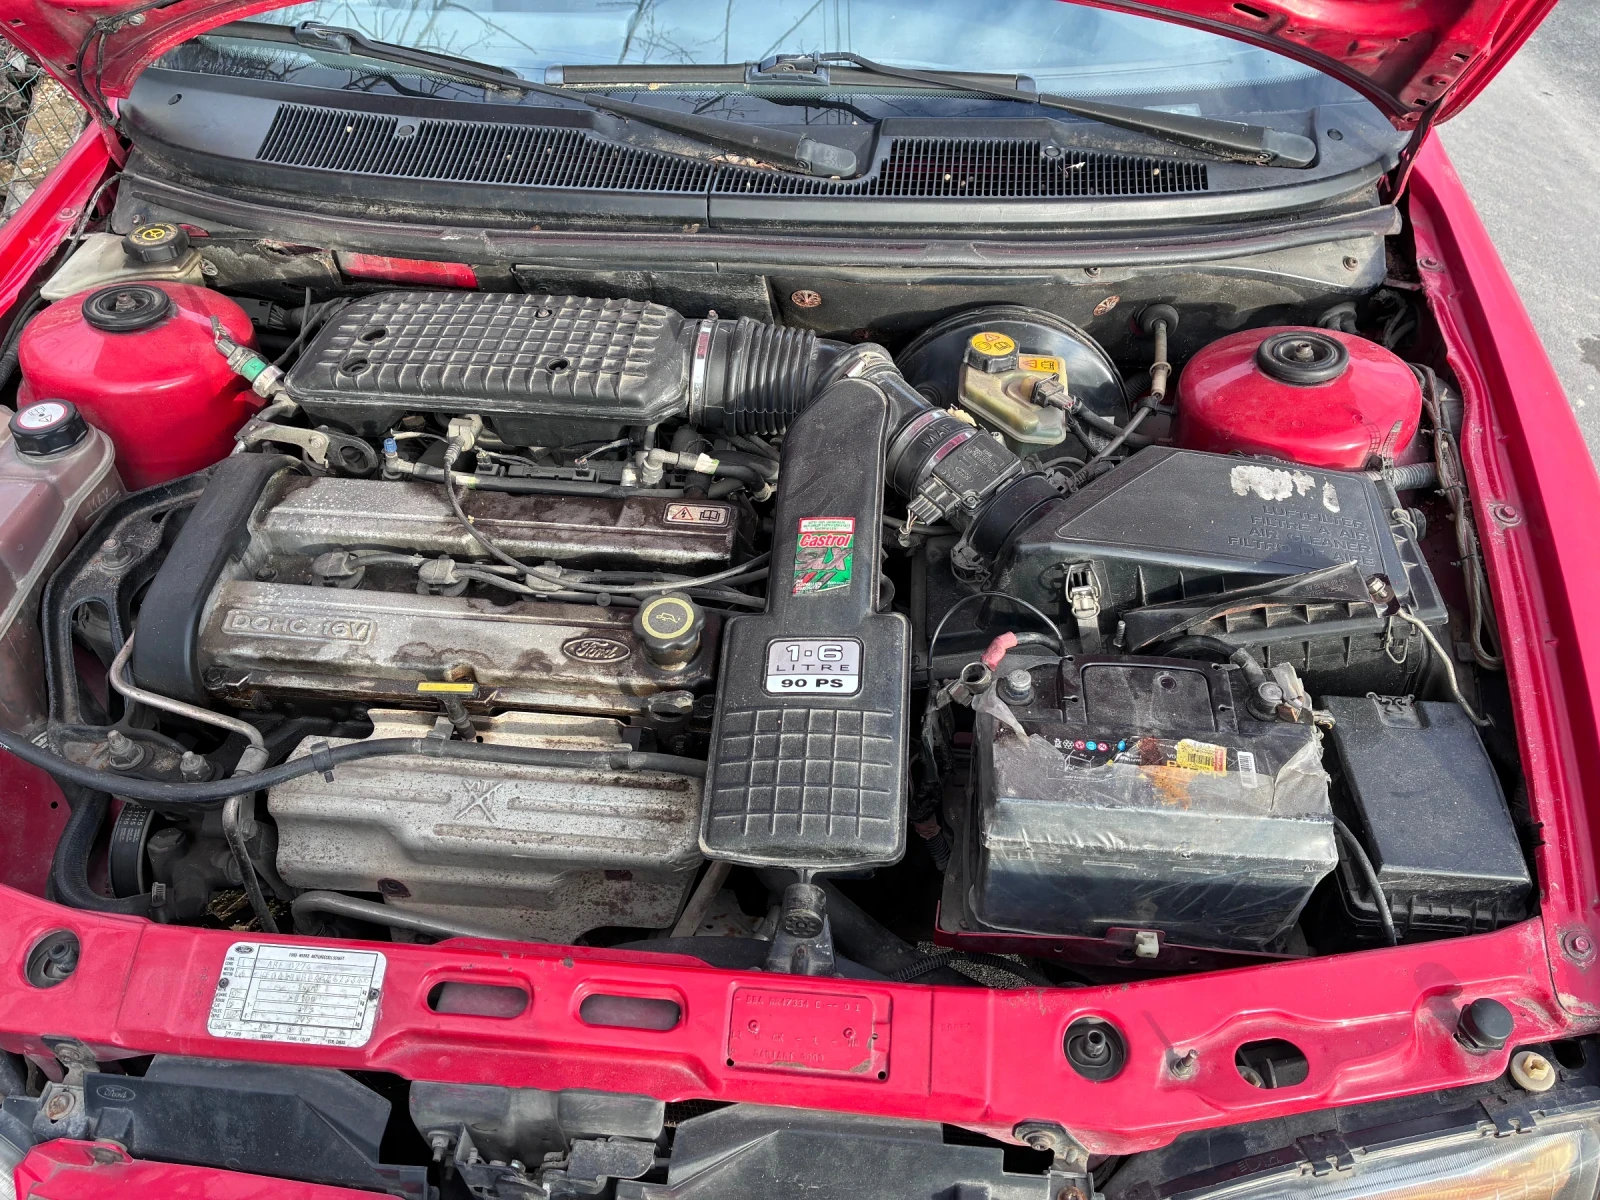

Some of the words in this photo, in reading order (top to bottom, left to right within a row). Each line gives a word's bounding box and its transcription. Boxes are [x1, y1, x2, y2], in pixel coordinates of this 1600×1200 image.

[921, 424, 951, 449] MAF
[1250, 514, 1311, 533] FILTRE
[1318, 525, 1331, 536] A
[1338, 528, 1370, 543] AIR
[1262, 504, 1367, 530] LUFTFILTER
[799, 533, 853, 547] Castrol
[1227, 535, 1292, 553] FILTRO
[1332, 551, 1376, 567] AIRE
[1248, 526, 1280, 540] AIR
[1287, 532, 1373, 555] CLEANER
[232, 613, 308, 634] DOHC
[322, 620, 369, 641] 16V
[776, 664, 850, 672] LITRE
[781, 678, 808, 688] 90
[815, 678, 844, 688] PS
